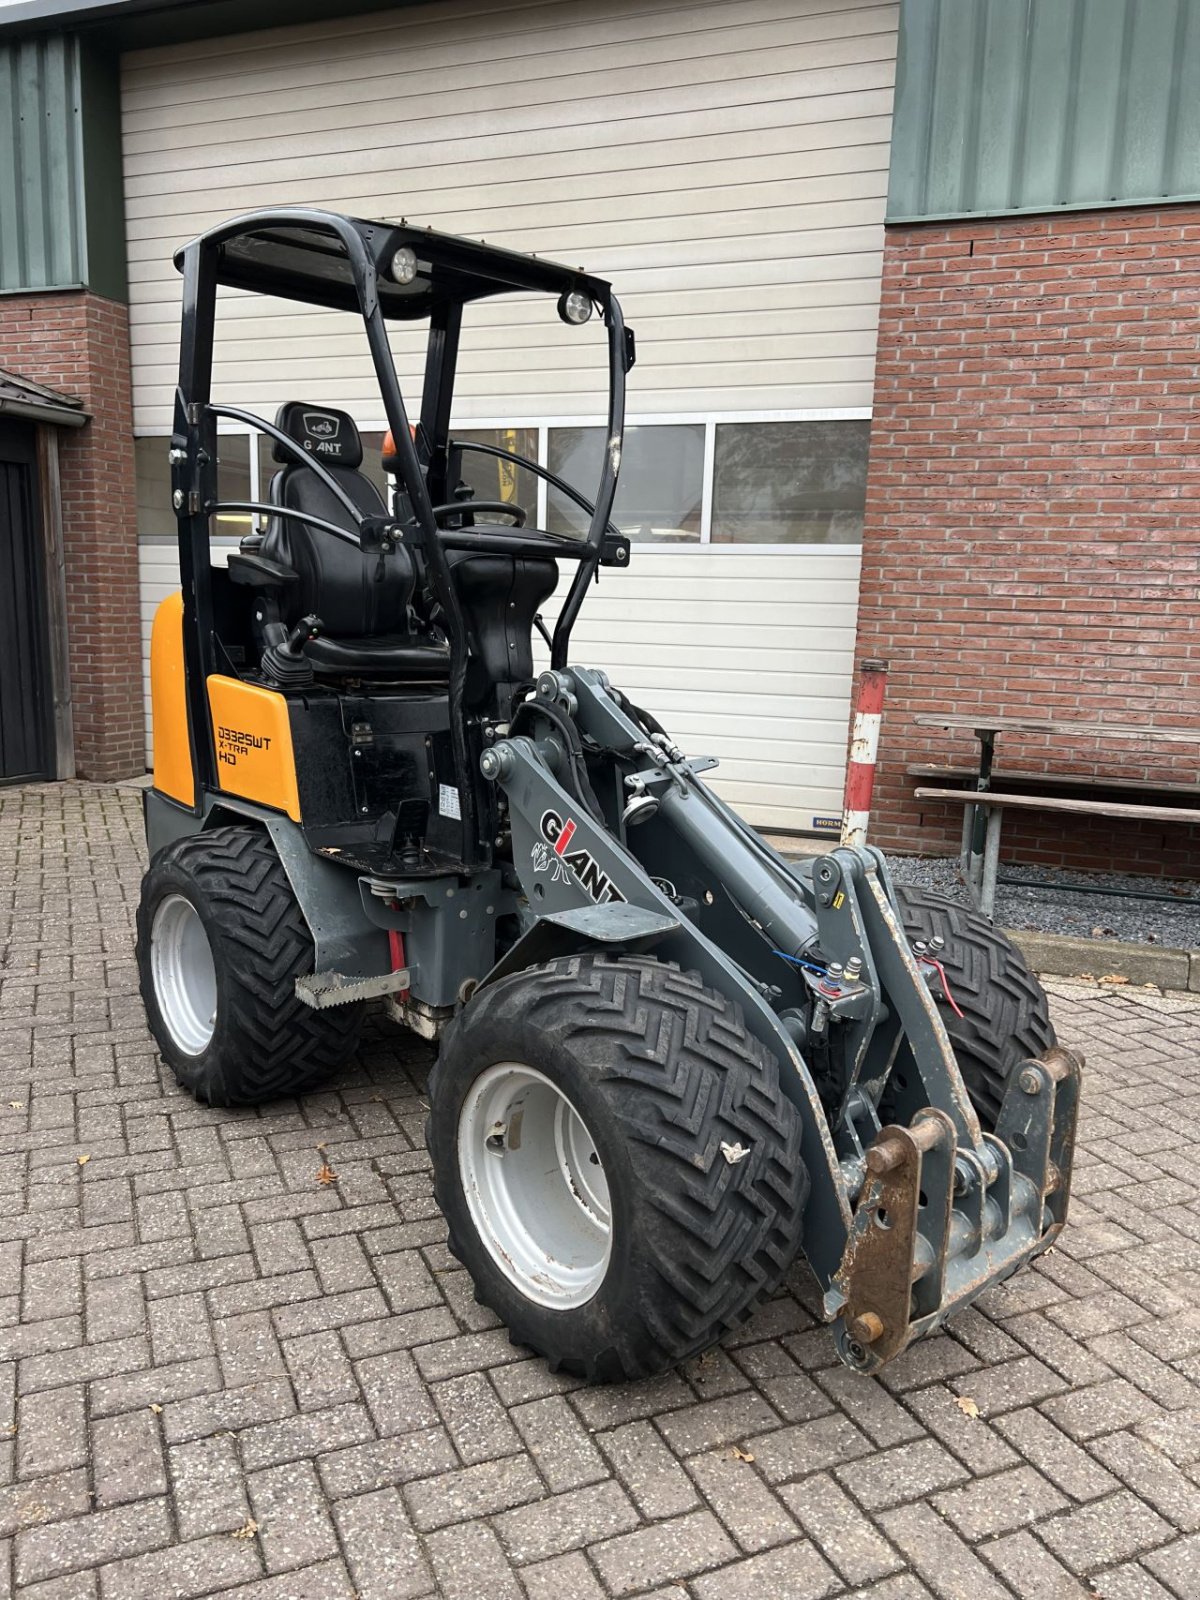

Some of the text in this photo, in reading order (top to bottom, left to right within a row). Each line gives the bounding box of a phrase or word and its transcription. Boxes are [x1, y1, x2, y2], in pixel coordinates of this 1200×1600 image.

[303, 440, 342, 453] GANT
[219, 740, 248, 756] X-TRA
[219, 750, 236, 766] HD
[815, 819, 841, 828] HORM
